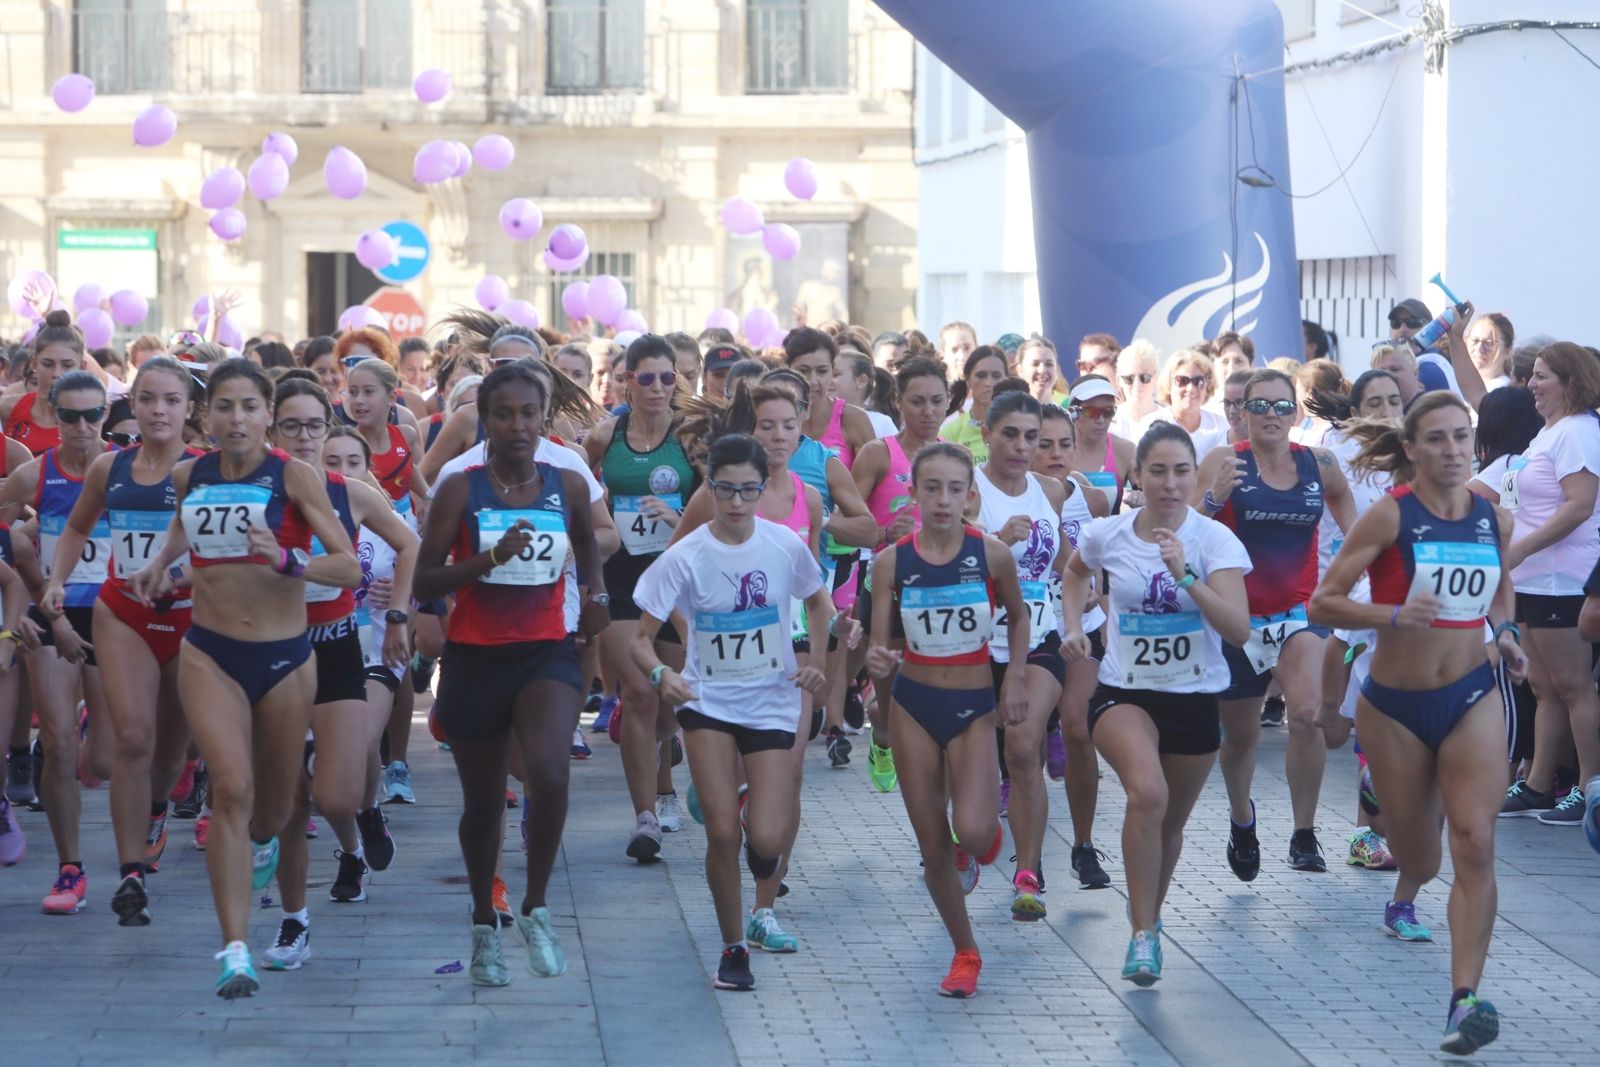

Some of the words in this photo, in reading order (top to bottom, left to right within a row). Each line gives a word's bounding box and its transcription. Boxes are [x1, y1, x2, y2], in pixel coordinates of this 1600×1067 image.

[381, 311, 424, 334] TOP
[195, 506, 252, 536] 273
[1245, 510, 1317, 522] Vanessa
[122, 532, 160, 559] 17
[1431, 566, 1486, 597] 100
[918, 606, 977, 635] 178
[711, 628, 765, 661] 171
[1133, 635, 1191, 666] 250
